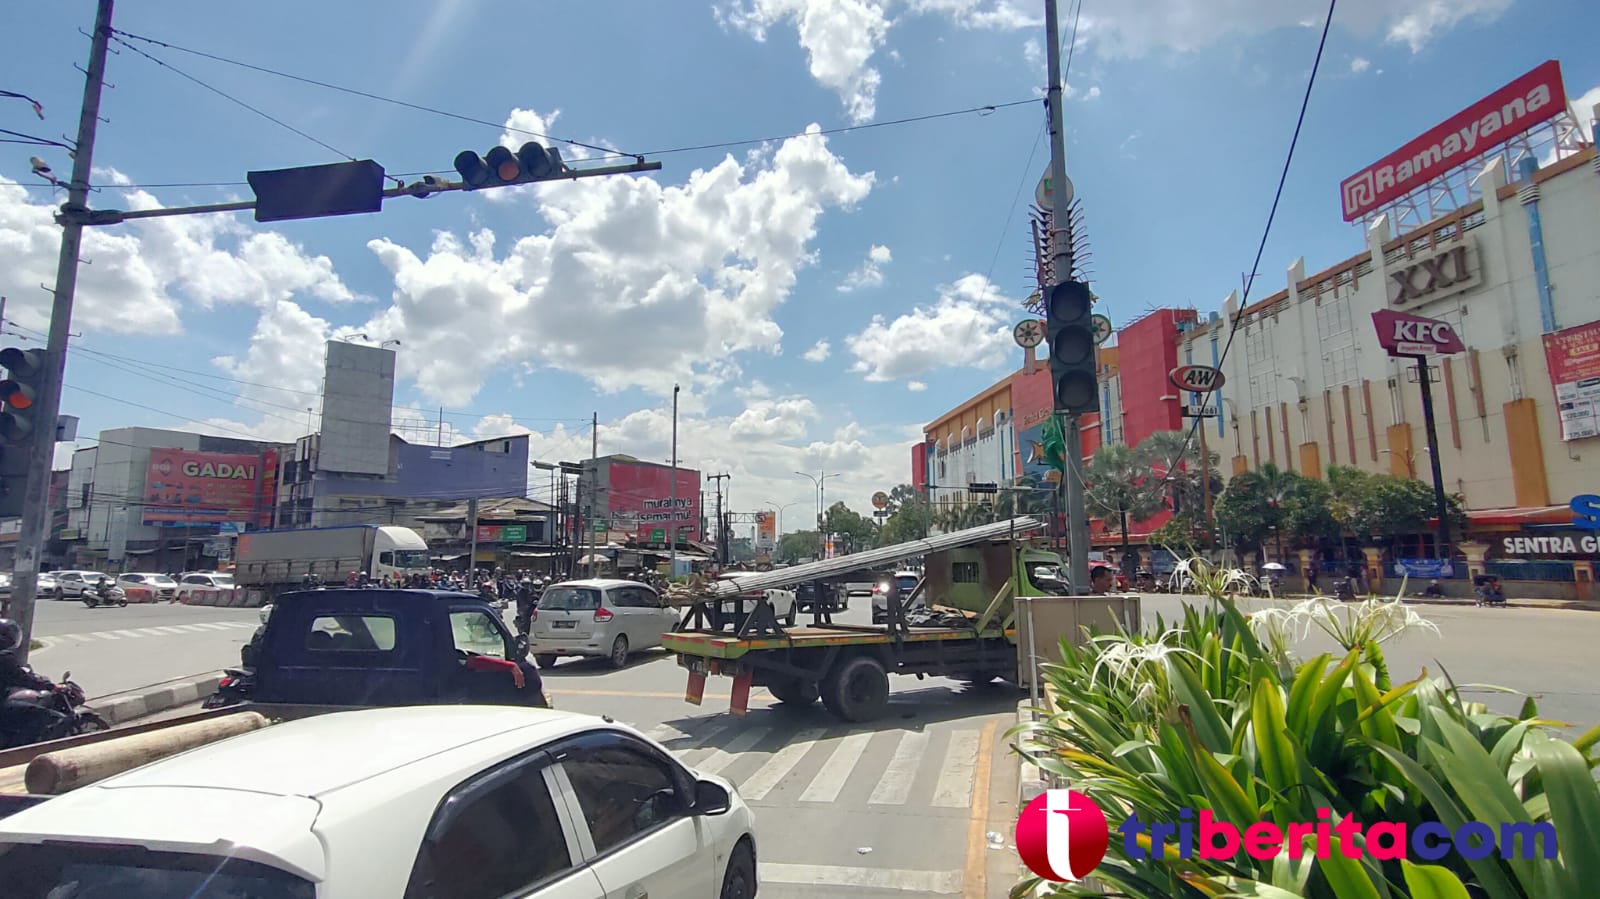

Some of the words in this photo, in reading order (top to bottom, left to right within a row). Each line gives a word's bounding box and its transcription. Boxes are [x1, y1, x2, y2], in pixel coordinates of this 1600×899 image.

[1375, 83, 1551, 193] Ramayana
[1390, 245, 1472, 305] XXI
[1393, 320, 1449, 344] KFC
[182, 461, 256, 480] GADAI
[1503, 536, 1577, 554] SENTRA
[1580, 536, 1600, 553] G
